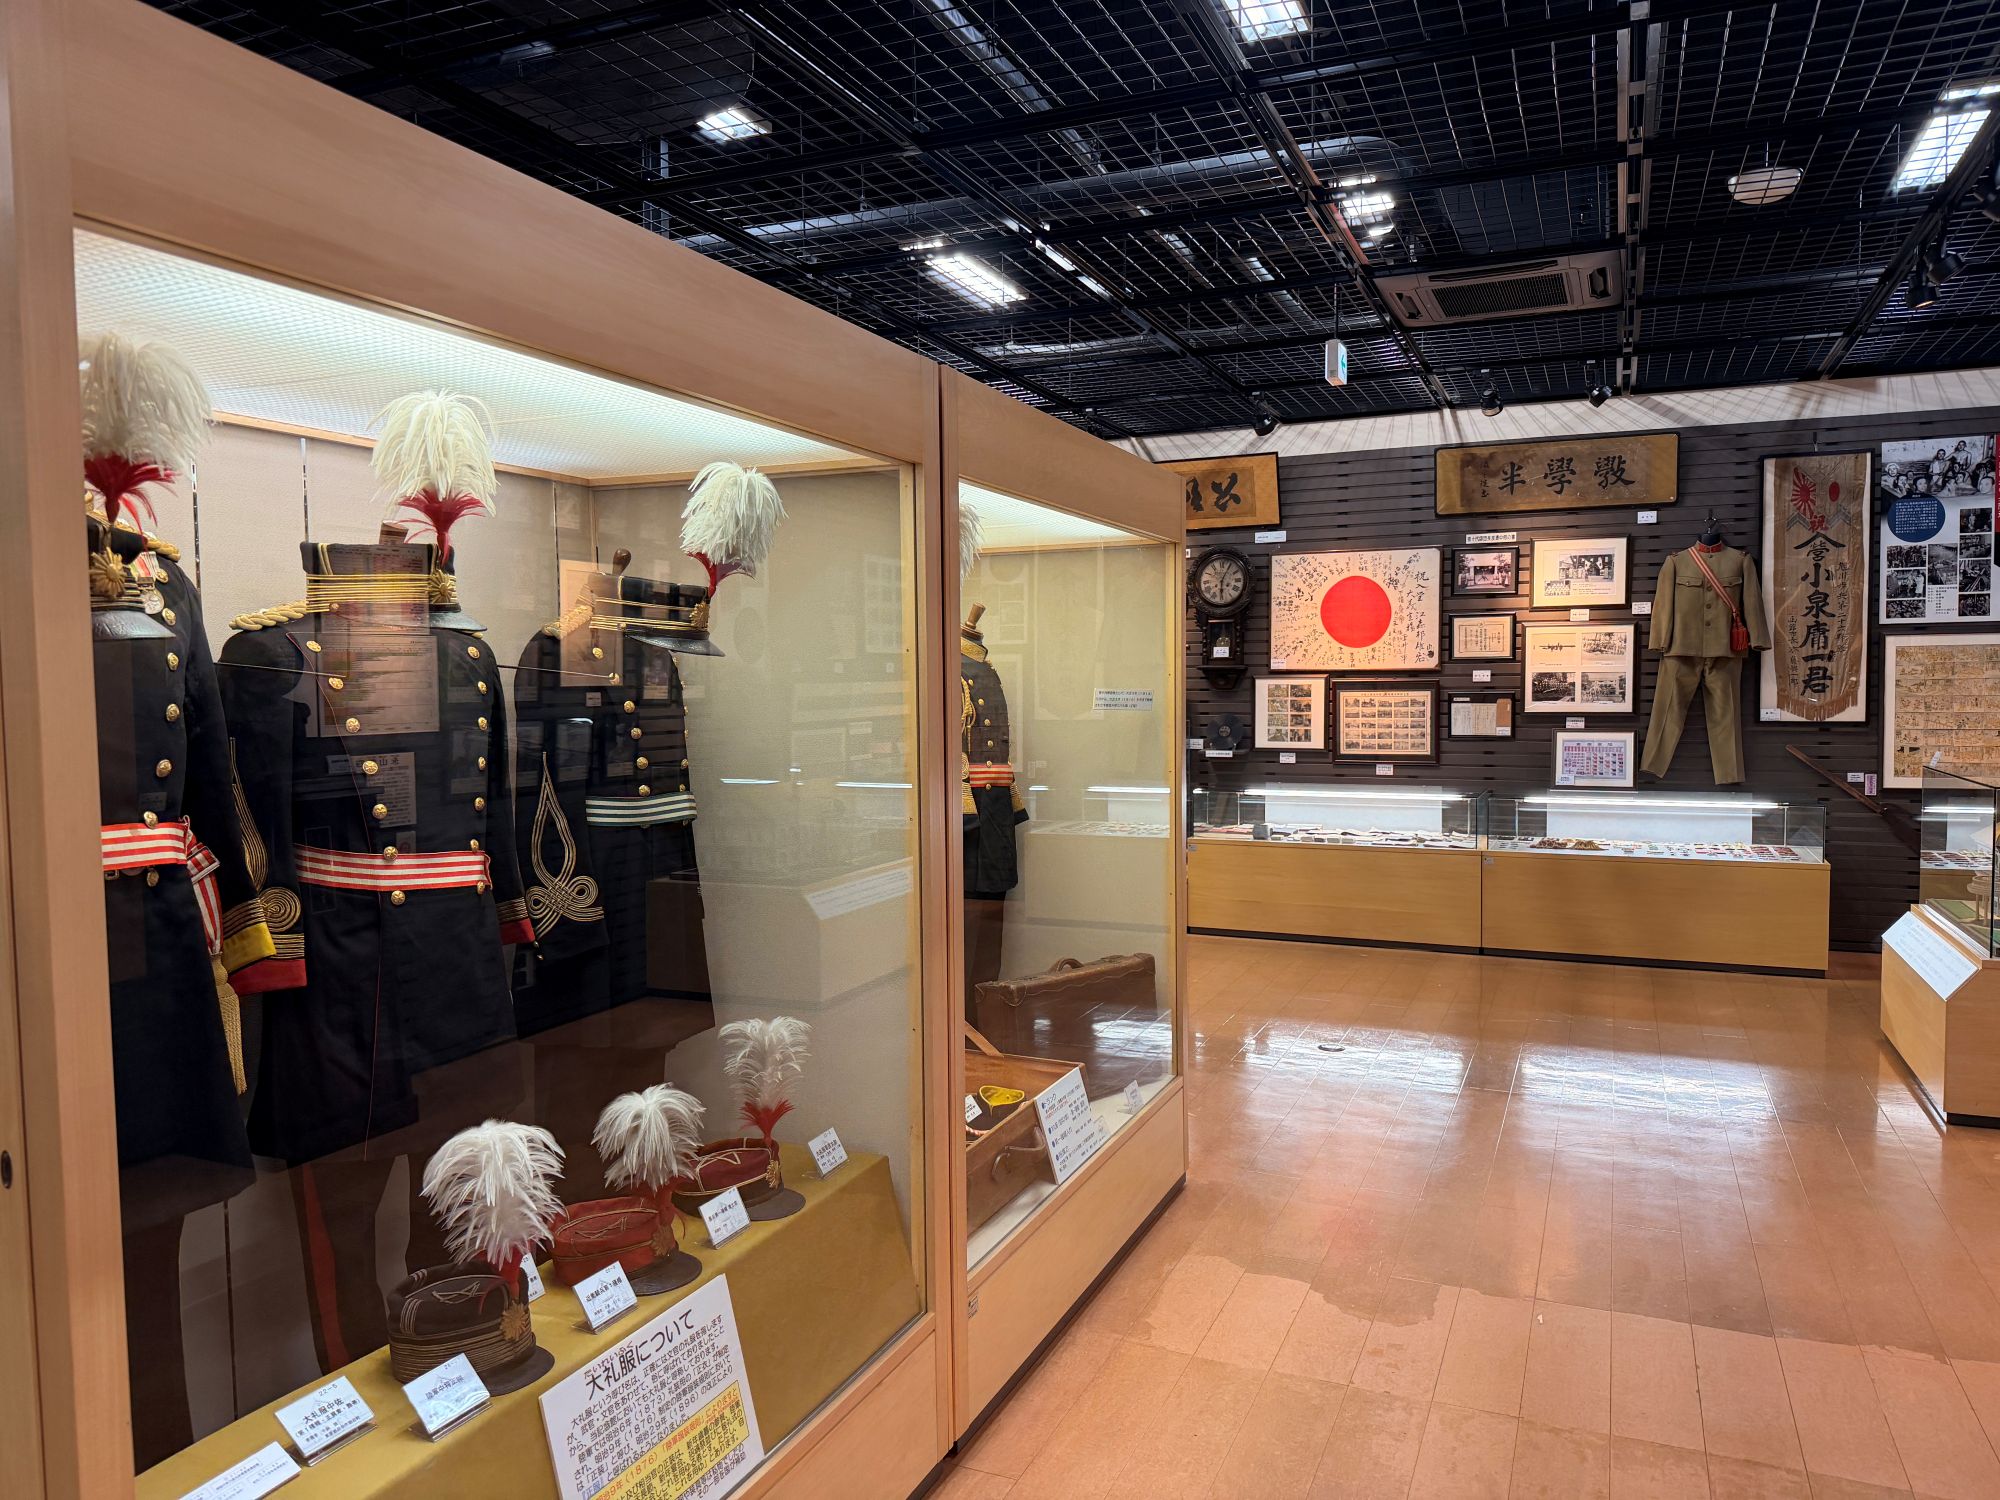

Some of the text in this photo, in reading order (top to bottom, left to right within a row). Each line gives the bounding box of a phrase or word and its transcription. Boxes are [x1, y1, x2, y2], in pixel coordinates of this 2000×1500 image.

[584, 1308, 695, 1401] 大礼服について
[303, 1397, 344, 1424] 大礼服中佐
